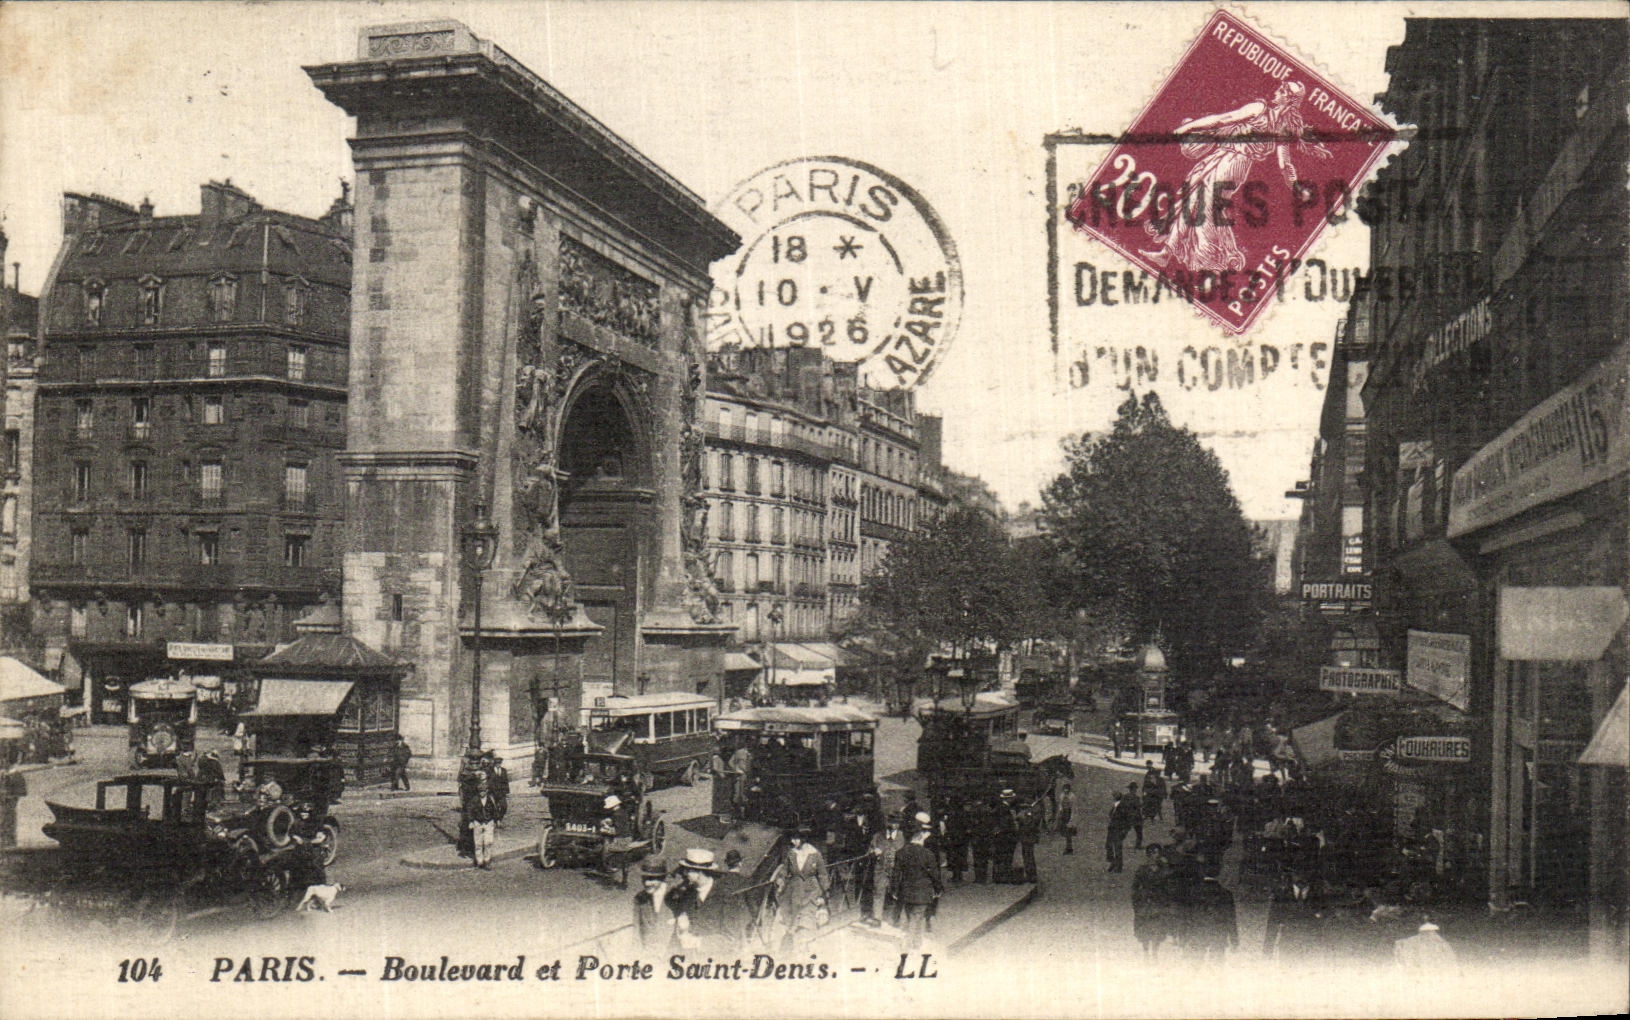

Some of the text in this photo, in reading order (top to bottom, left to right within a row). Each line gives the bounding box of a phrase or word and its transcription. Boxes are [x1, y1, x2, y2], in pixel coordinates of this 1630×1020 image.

[1307, 87, 1373, 147] FRANÇA
[1099, 153, 1157, 219] 20
[1303, 583, 1373, 599] PORTRAITS
[1321, 668, 1401, 690] PHOTOGRAPHIE
